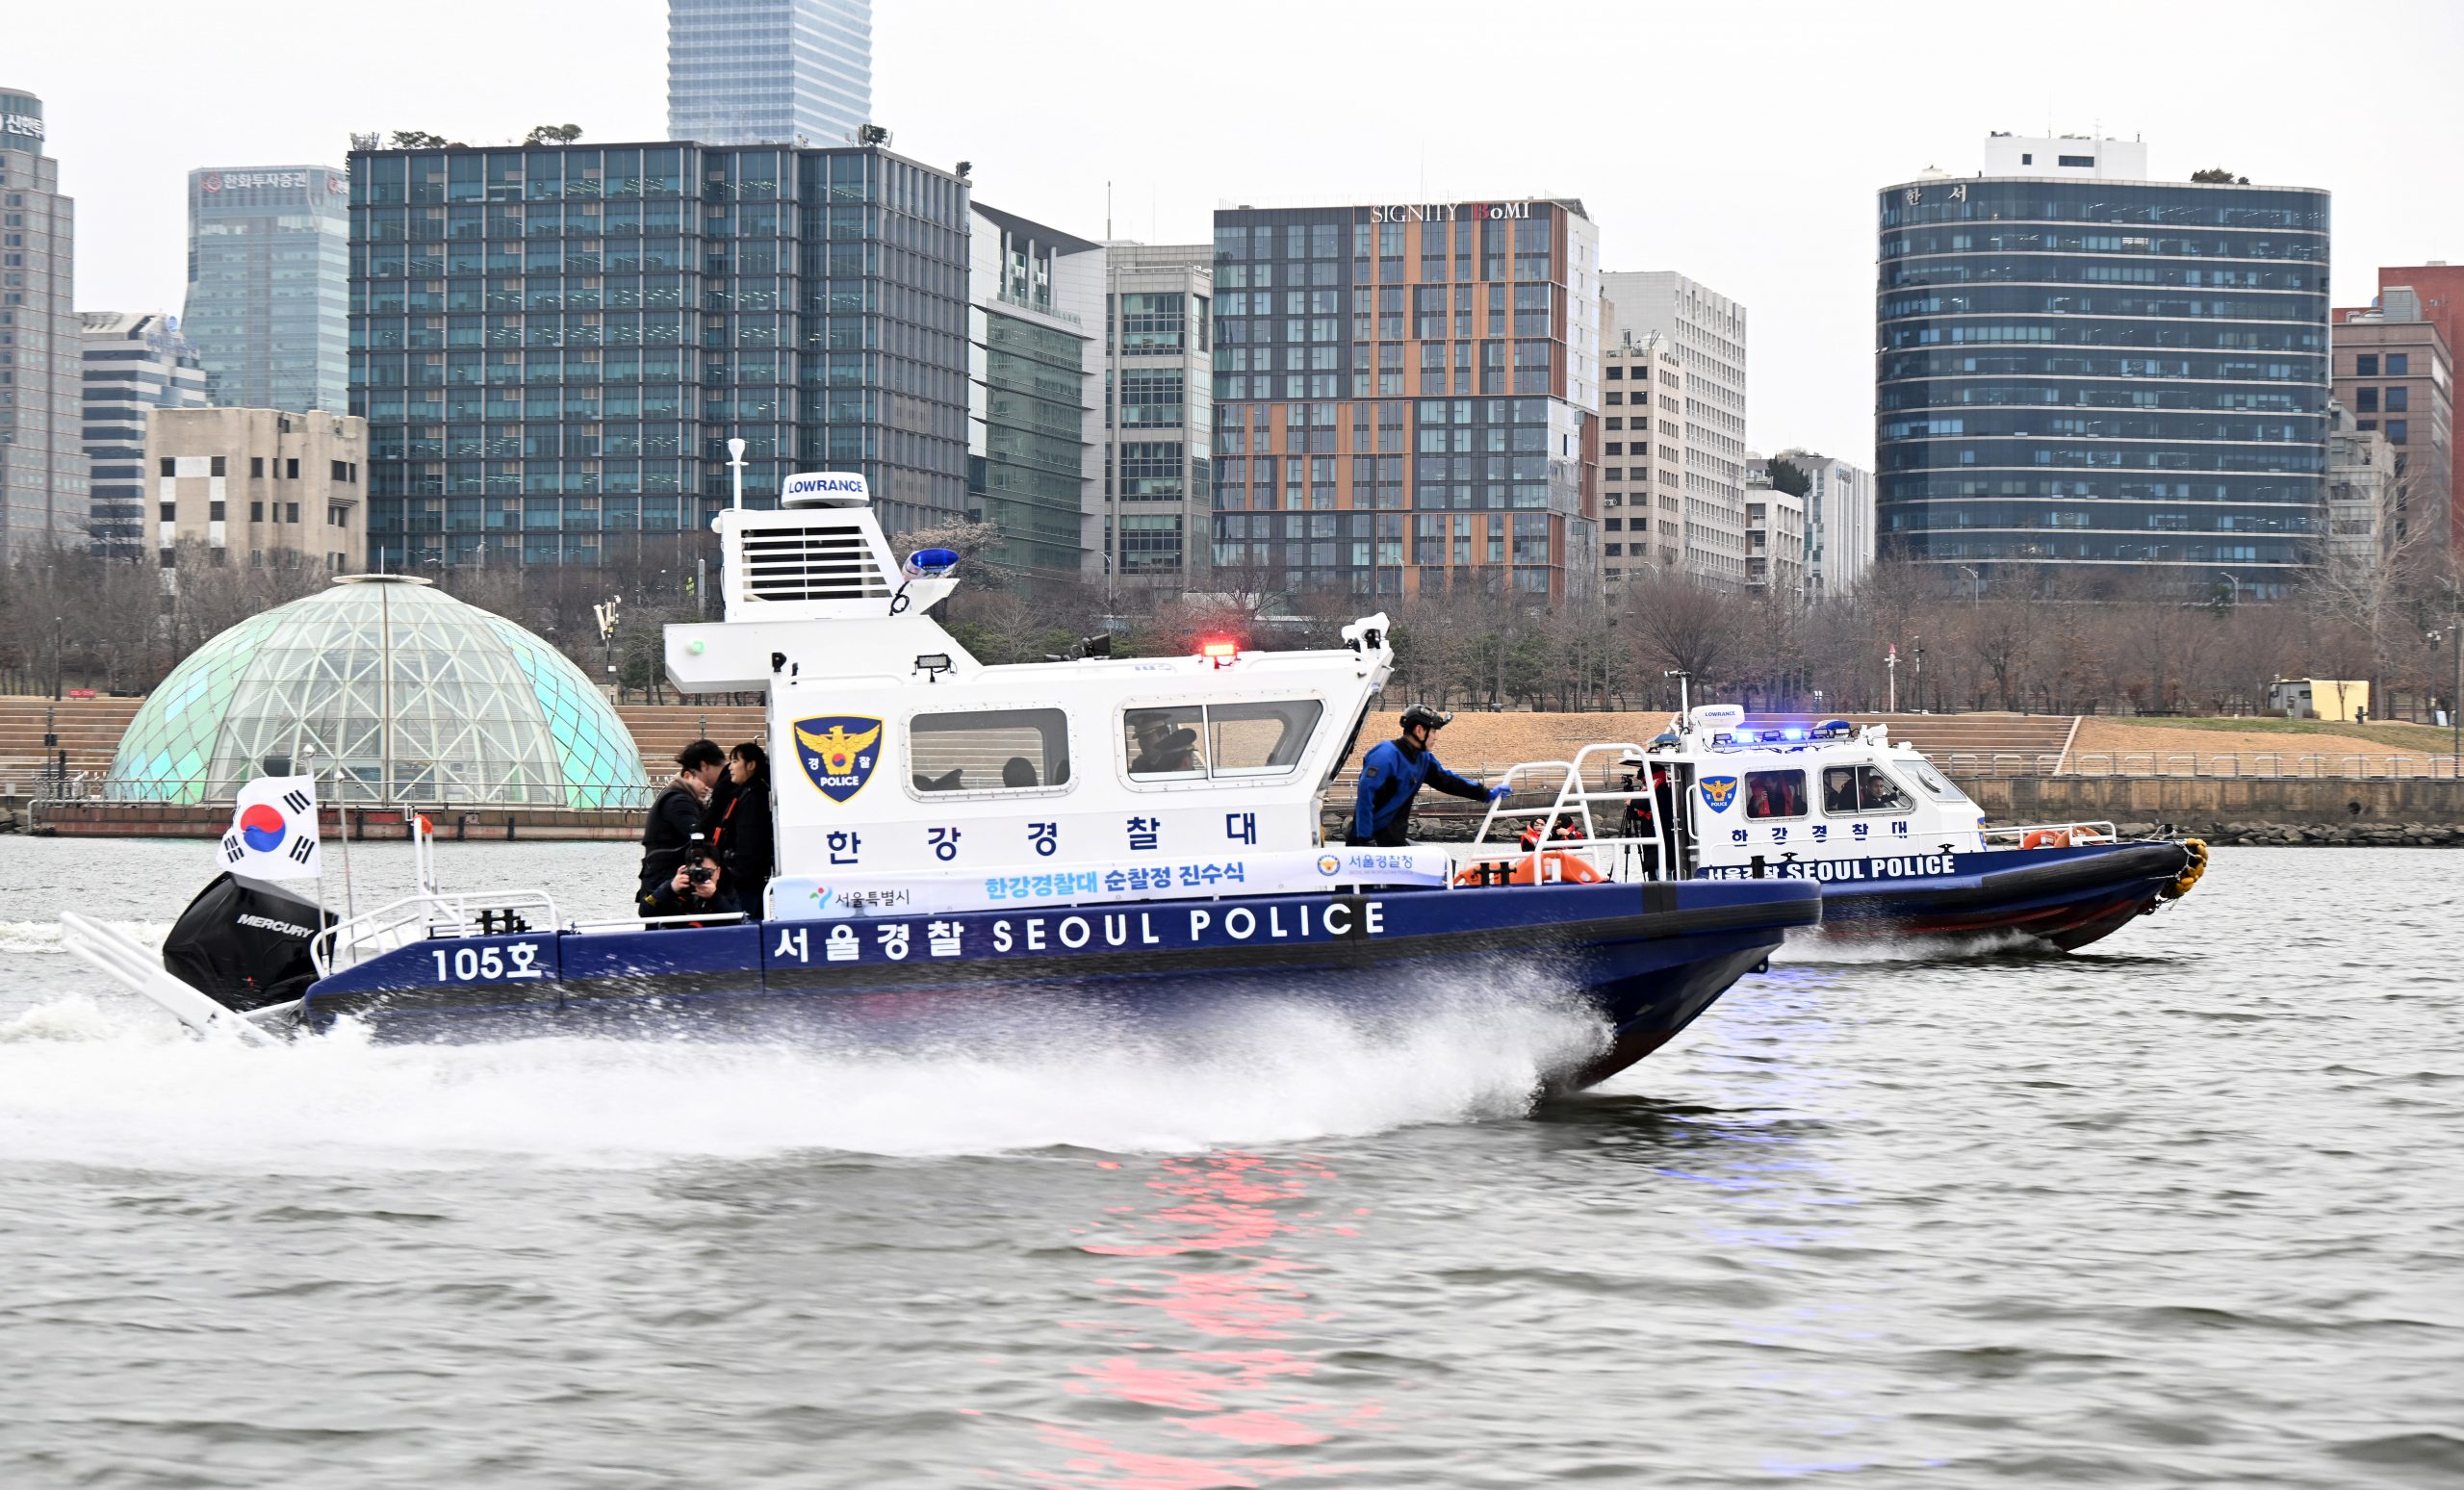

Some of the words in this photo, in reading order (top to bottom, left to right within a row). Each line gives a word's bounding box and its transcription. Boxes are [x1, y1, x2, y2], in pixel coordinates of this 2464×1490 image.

[223, 172, 307, 190] 한화투자증권
[1372, 202, 1459, 223] SIGNITY
[788, 479, 863, 494] LOWRANCE
[820, 775, 860, 786] POLICE
[1348, 854, 1413, 869] 서울경찰청
[1786, 861, 1865, 881] SEOUL
[1870, 855, 1956, 878] POLICE
[985, 871, 1098, 900] 한강경찰대
[1104, 866, 1171, 892] 순찰정
[1179, 861, 1245, 886] 진수식
[835, 888, 910, 908] 서울특별시
[237, 913, 315, 938] MERCURY
[774, 920, 964, 963] 서울경찰
[992, 912, 1160, 952] SEOUL
[1190, 902, 1384, 940] POLICE
[432, 941, 542, 982] 105호
